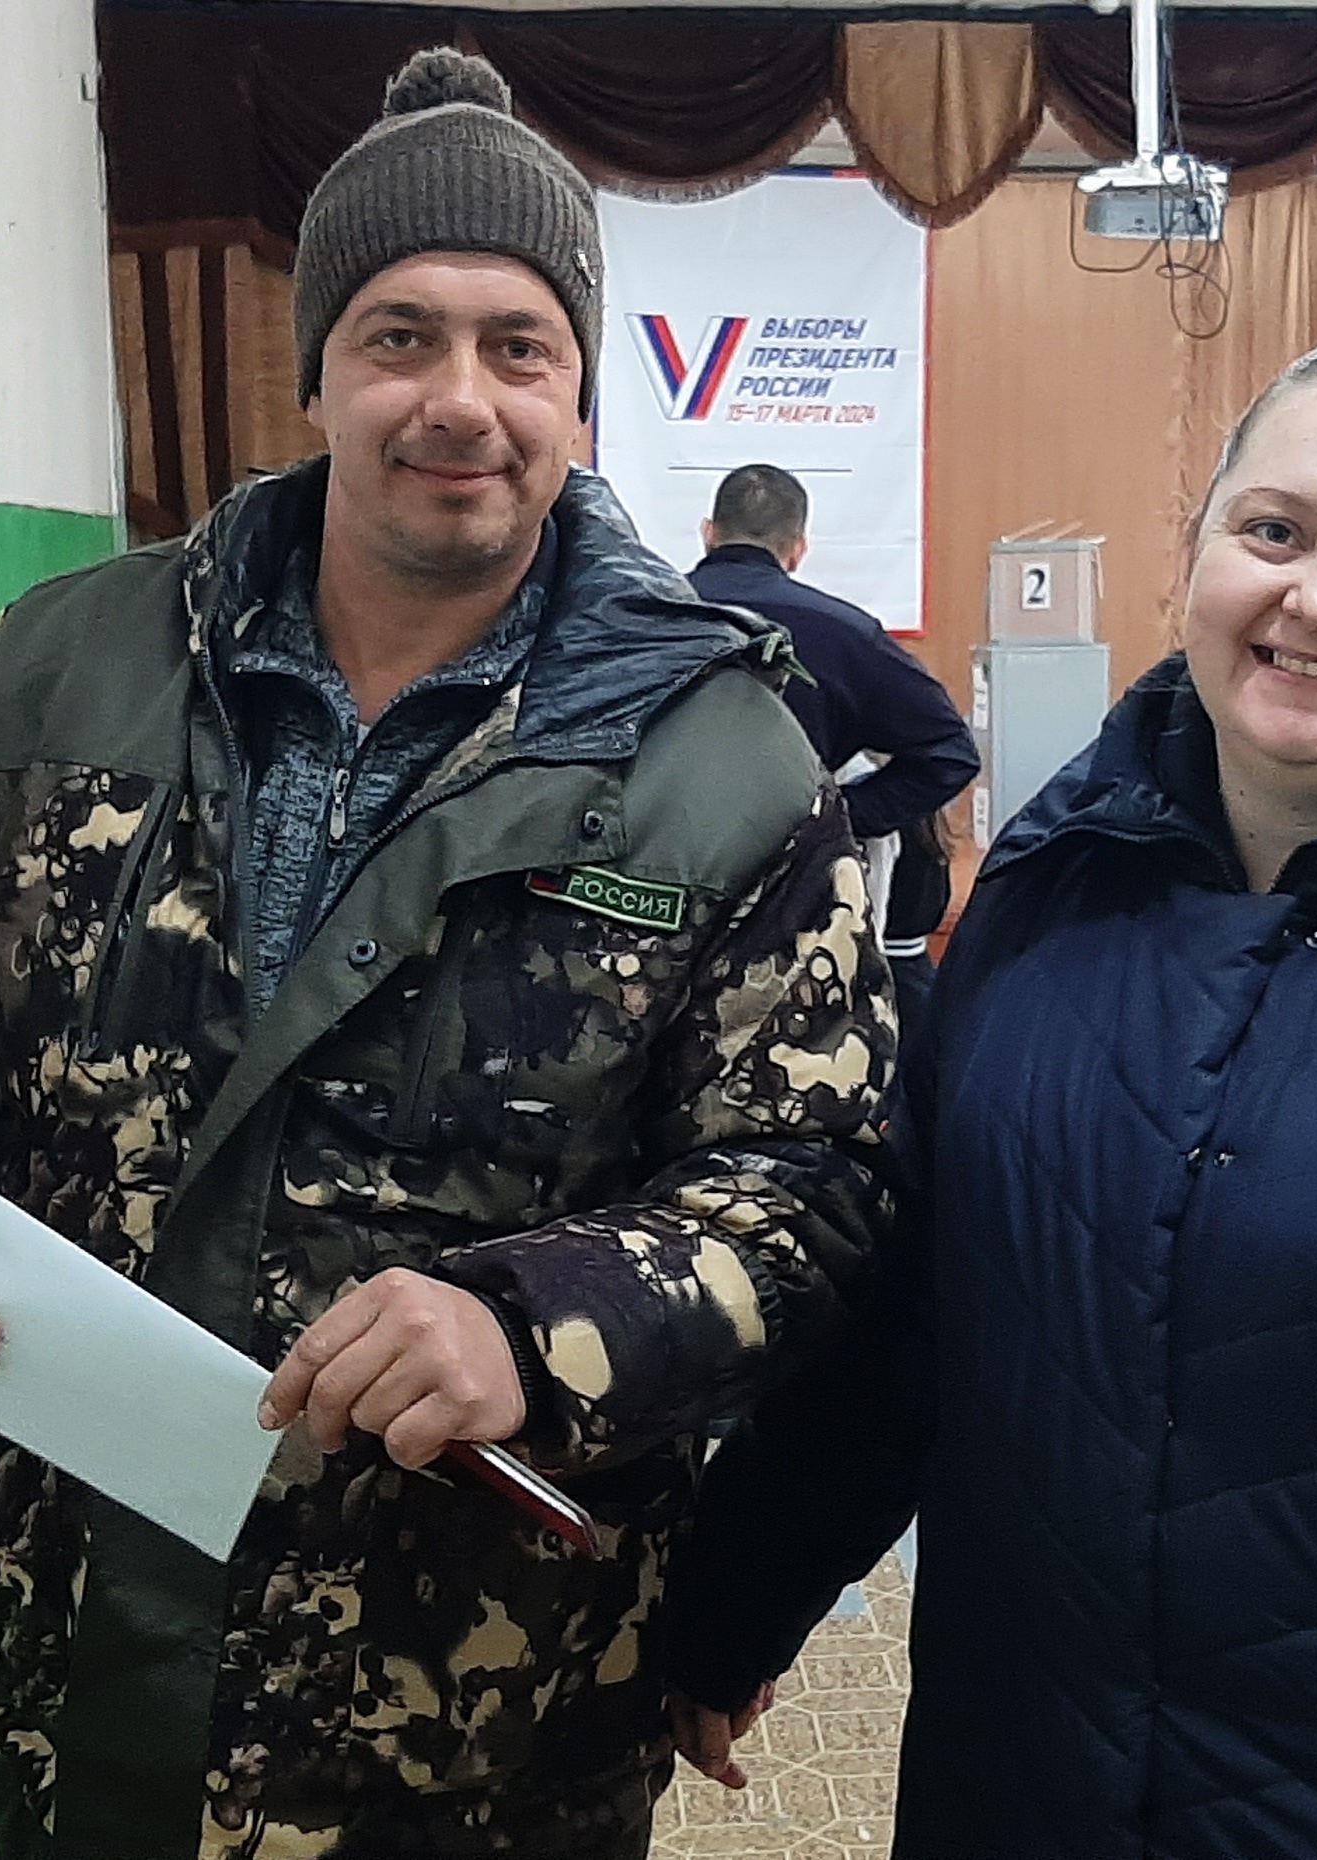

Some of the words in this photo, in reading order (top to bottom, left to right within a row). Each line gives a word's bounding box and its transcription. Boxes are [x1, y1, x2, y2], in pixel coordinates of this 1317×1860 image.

[760, 317, 867, 340] ВЫБОРЫ
[747, 347, 897, 370] ПРЕЗИДЕНТА
[736, 376, 833, 398] РОССИИ
[834, 405, 875, 423] 2024
[1027, 568, 1046, 605] 2
[566, 874, 671, 920] РОССИЯ
